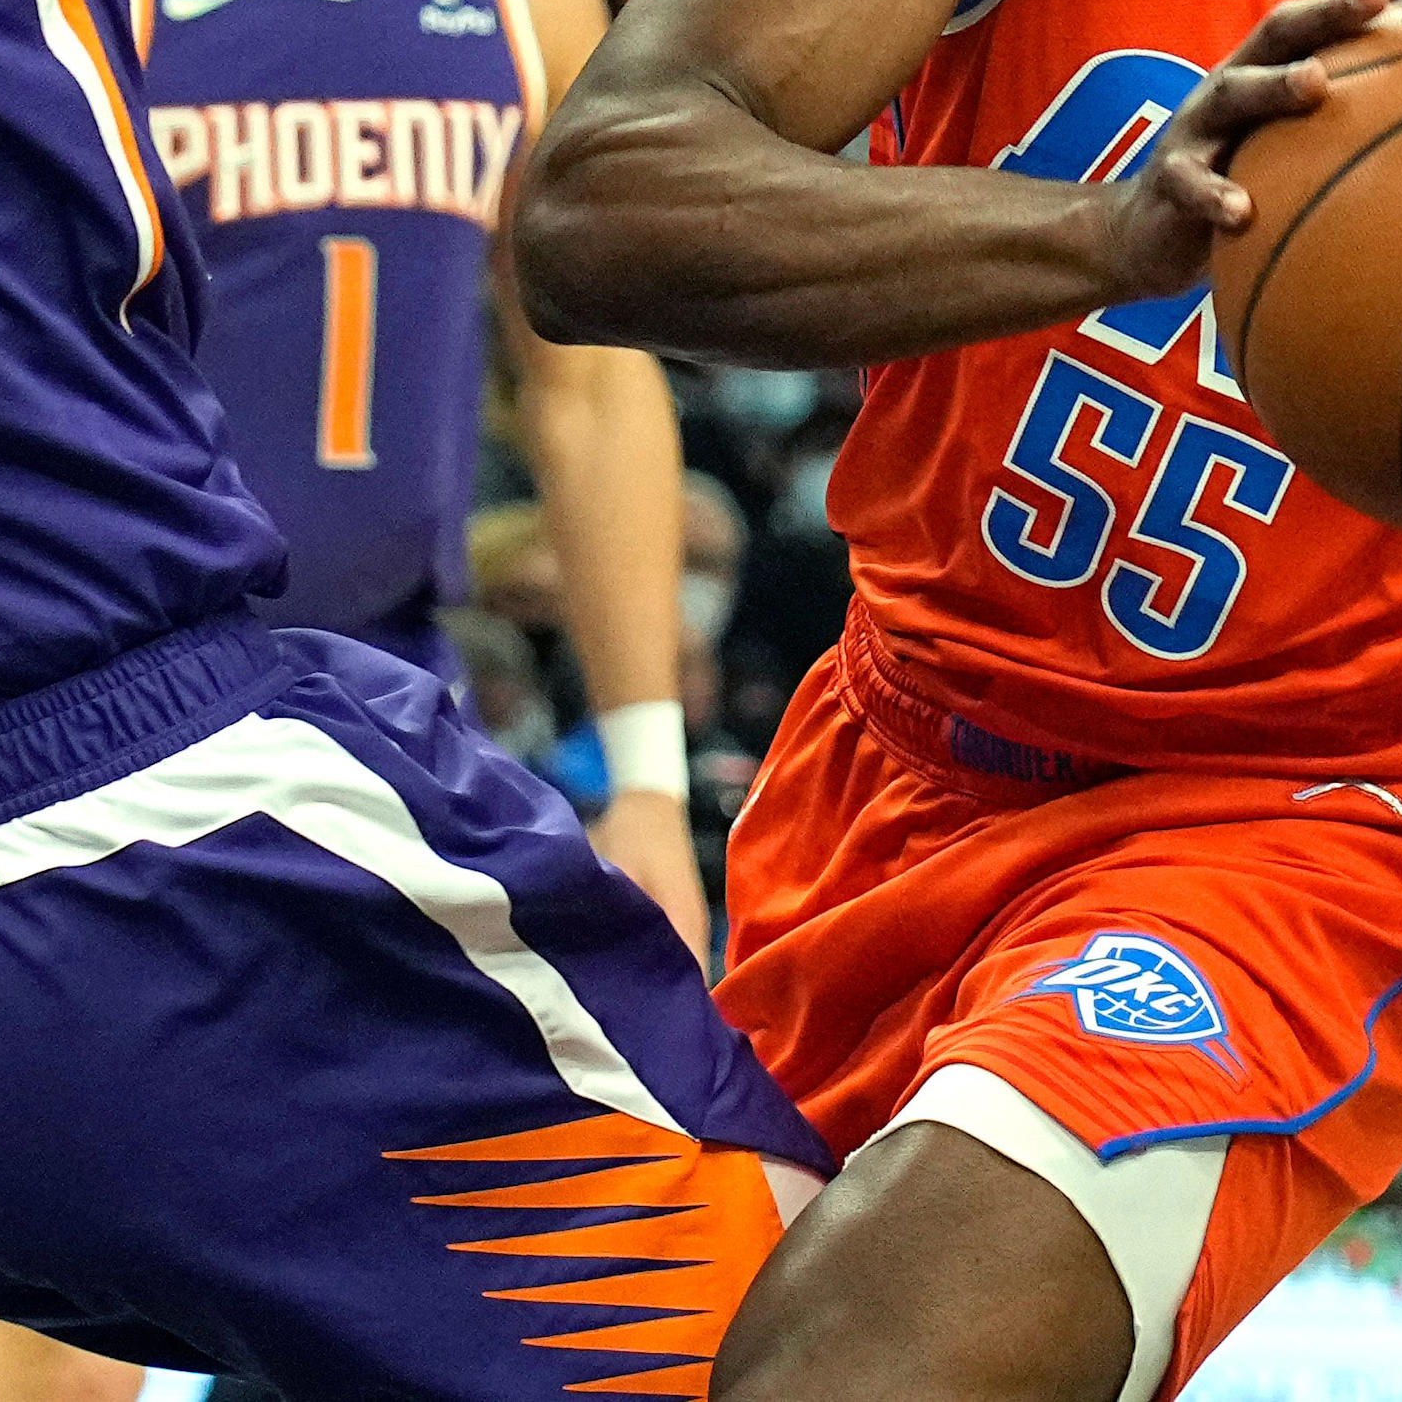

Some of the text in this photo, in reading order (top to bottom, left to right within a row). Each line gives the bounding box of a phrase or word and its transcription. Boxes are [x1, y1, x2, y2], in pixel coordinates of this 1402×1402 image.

[148, 98, 523, 233] PHOENIX
[316, 236, 378, 469] 1
[980, 348, 1295, 661] 55
[1042, 957, 1196, 1015] OKC
